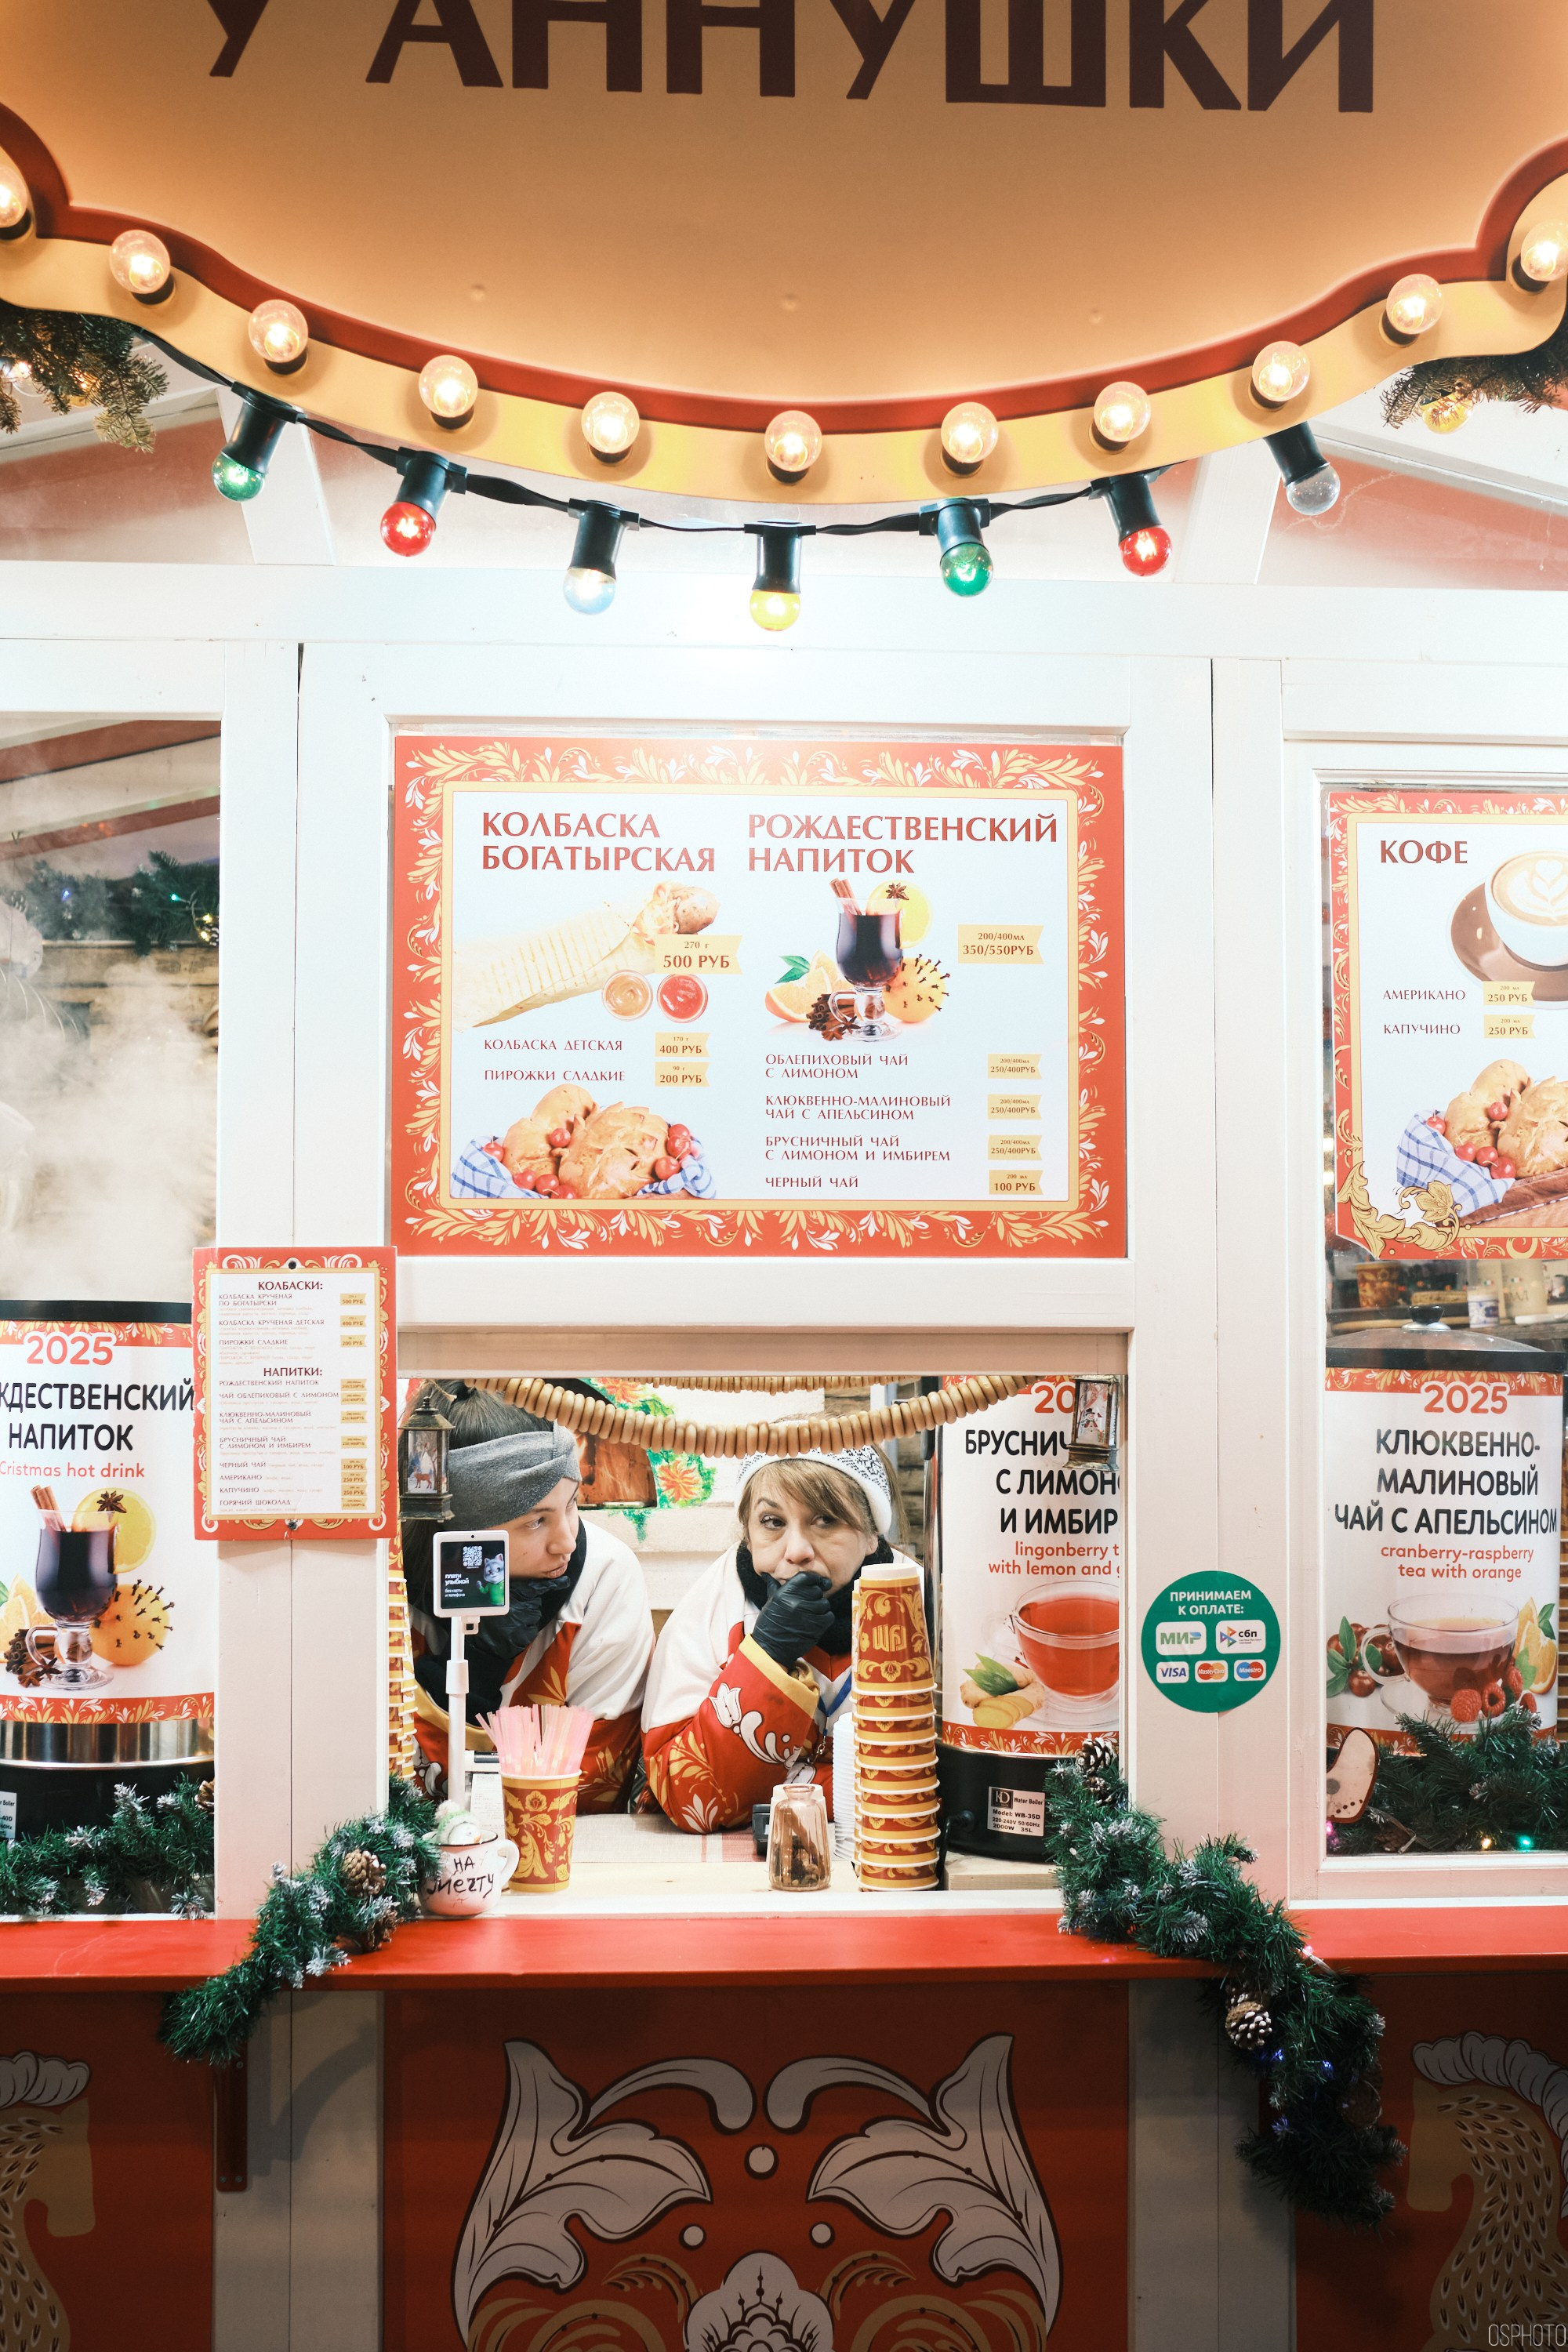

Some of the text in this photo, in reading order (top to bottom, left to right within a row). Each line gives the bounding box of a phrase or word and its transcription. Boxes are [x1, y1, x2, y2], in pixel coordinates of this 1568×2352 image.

[365, 0, 1374, 113] АННУШКИ
[483, 811, 661, 838] КОЛБАСКА
[749, 813, 1057, 843] РОЖДЕСТВЕНСКИЙ
[482, 844, 715, 872] БОГАТЫРСКАЯ
[1381, 840, 1468, 864] КОФЕ
[749, 848, 915, 873] НАПИТОК
[978, 932, 1025, 942] 200/400мл
[963, 944, 1034, 956] 350/550РУБ
[663, 955, 730, 968] 500 РУБ
[1383, 989, 1466, 1000] АМЕРИКАНО
[1488, 993, 1527, 1003] 250 РУБ
[1384, 1024, 1461, 1034] КАПУЧИНО
[1489, 1026, 1528, 1036] 250 РУБ
[485, 1039, 622, 1051] КОЛБАСКА ДЕТСКАЯ
[659, 1045, 702, 1054] 400 РУБ
[766, 1054, 908, 1065] ОБЛЕПИХОВЫЙ ЧАЙ
[485, 1070, 626, 1081] ПИРОЖКИ СЛАДКИЕ
[659, 1074, 702, 1083] 200 РУБ
[766, 1068, 858, 1079] С ЛИМОНОМ
[766, 1094, 951, 1106] КЛЮКВЕННО-МАЛИНОВЫЙ
[766, 1107, 913, 1120] ЧАЙ С АПЕЛЬСИНОМ
[766, 1135, 899, 1147] БРУСНИЧНЫЙ ЧАЙ
[766, 1150, 950, 1161] С ЛИМОНОМ И ИМБИРЕМ
[766, 1175, 858, 1188] ЧЕРНЫЙ ЧАЙ
[994, 1182, 1036, 1191] 100 РУБ
[258, 1281, 323, 1290] КОЛБАСКИ:
[27, 1335, 114, 1366] 2025
[263, 1367, 322, 1377] НАПИТКИ:
[1424, 1384, 1508, 1414] 2025
[9, 1422, 133, 1450] НАПИТОК
[1376, 1428, 1541, 1457] КЛЮКВЕННО-
[0, 1461, 145, 1478] Cristmas hot drink
[996, 1468, 1120, 1495] С ЛИМОН
[1377, 1464, 1538, 1496] МАЛИНОВЫЙ
[1000, 1508, 1118, 1534] И ИМБИР
[1335, 1499, 1557, 1535] ЧАЙ С АПЕЛЬСИНОМ
[1015, 1541, 1108, 1560] lingonberry
[1381, 1544, 1534, 1563] cranberry-raspberry
[989, 1559, 1021, 1574] with
[1026, 1560, 1076, 1575] lemon
[1081, 1561, 1112, 1575] and
[1398, 1563, 1522, 1582] tea with orange
[1170, 1590, 1252, 1602] ПРИНИМАЕМ
[1178, 1604, 1244, 1615] К ОПЛАТЕ:
[1160, 1632, 1202, 1645] МИР
[1238, 1629, 1258, 1638] сбп
[1160, 1668, 1187, 1677] VISA
[453, 1856, 475, 1872] НА
